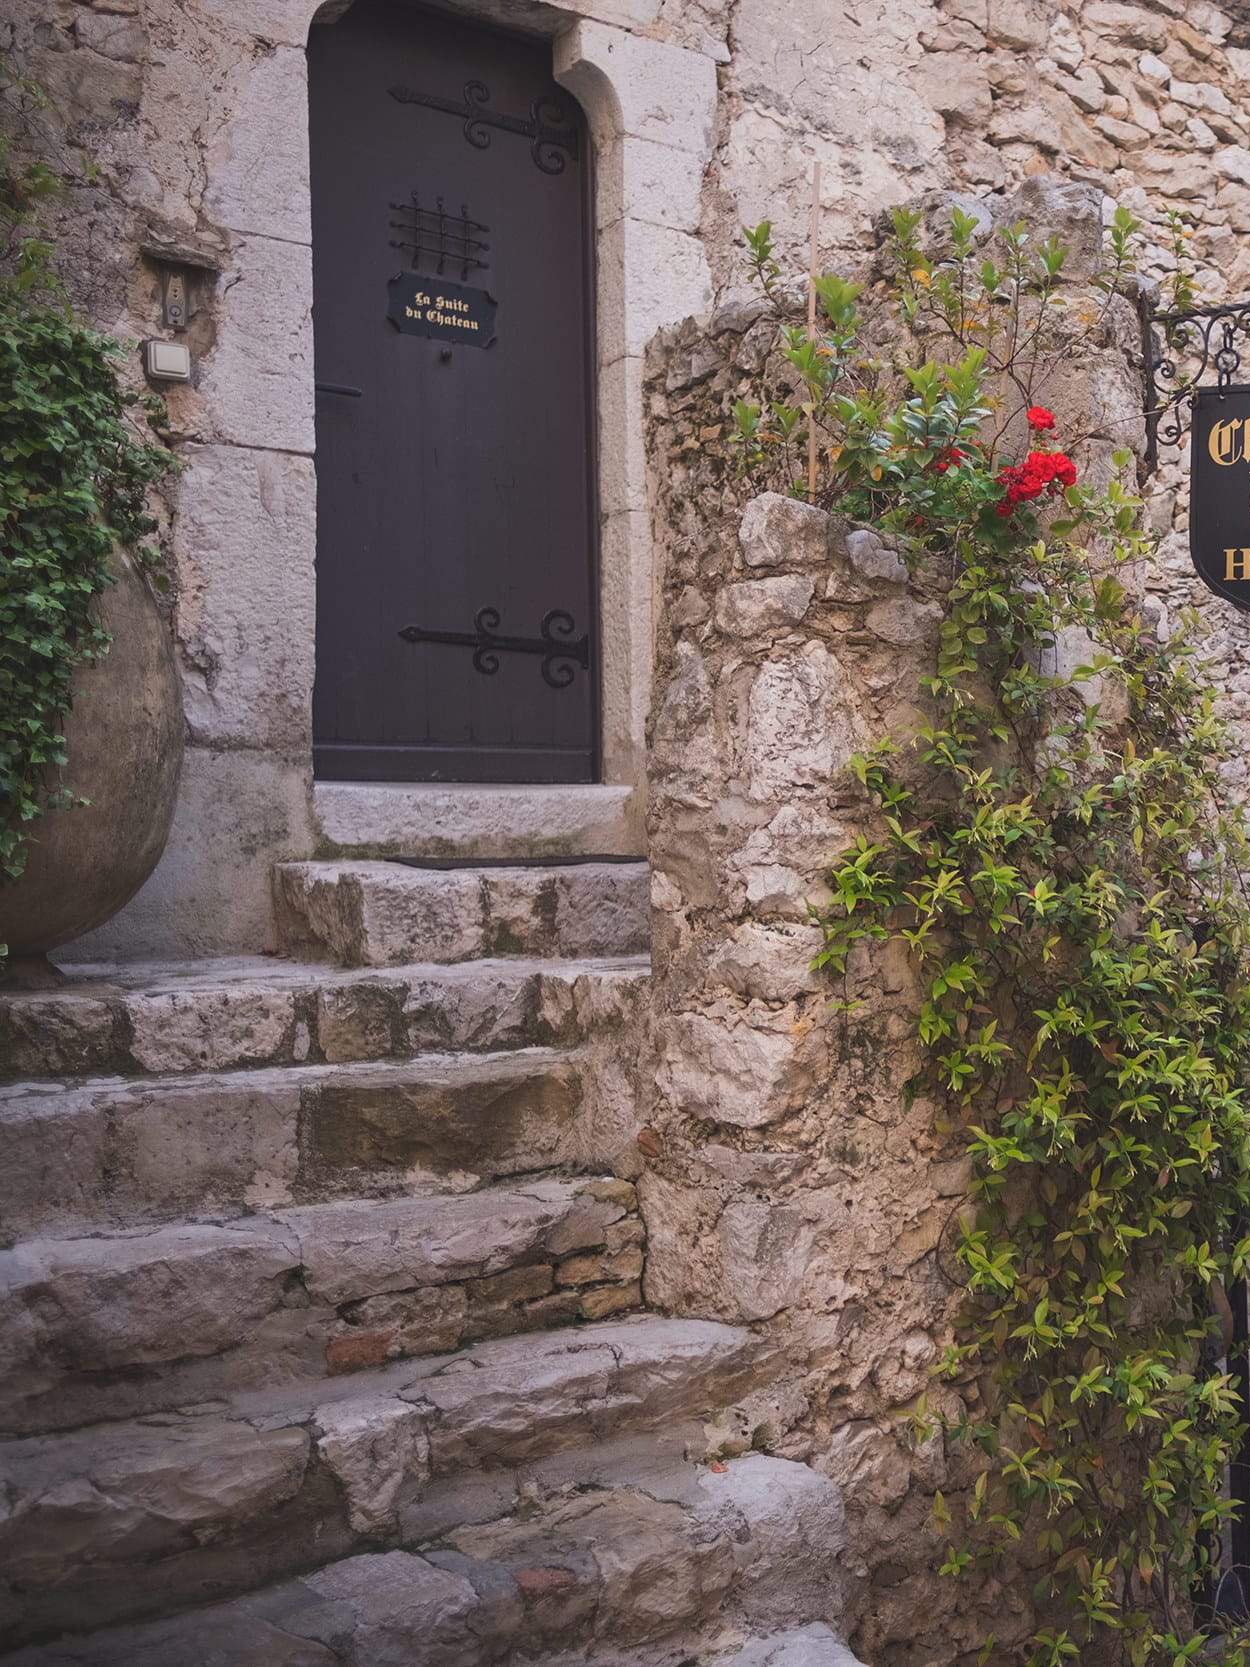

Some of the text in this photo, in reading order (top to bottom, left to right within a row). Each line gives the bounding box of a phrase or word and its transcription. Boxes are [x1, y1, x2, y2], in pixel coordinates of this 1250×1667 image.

[415, 291, 470, 312] La Suite
[405, 305, 479, 331] du Chateau
